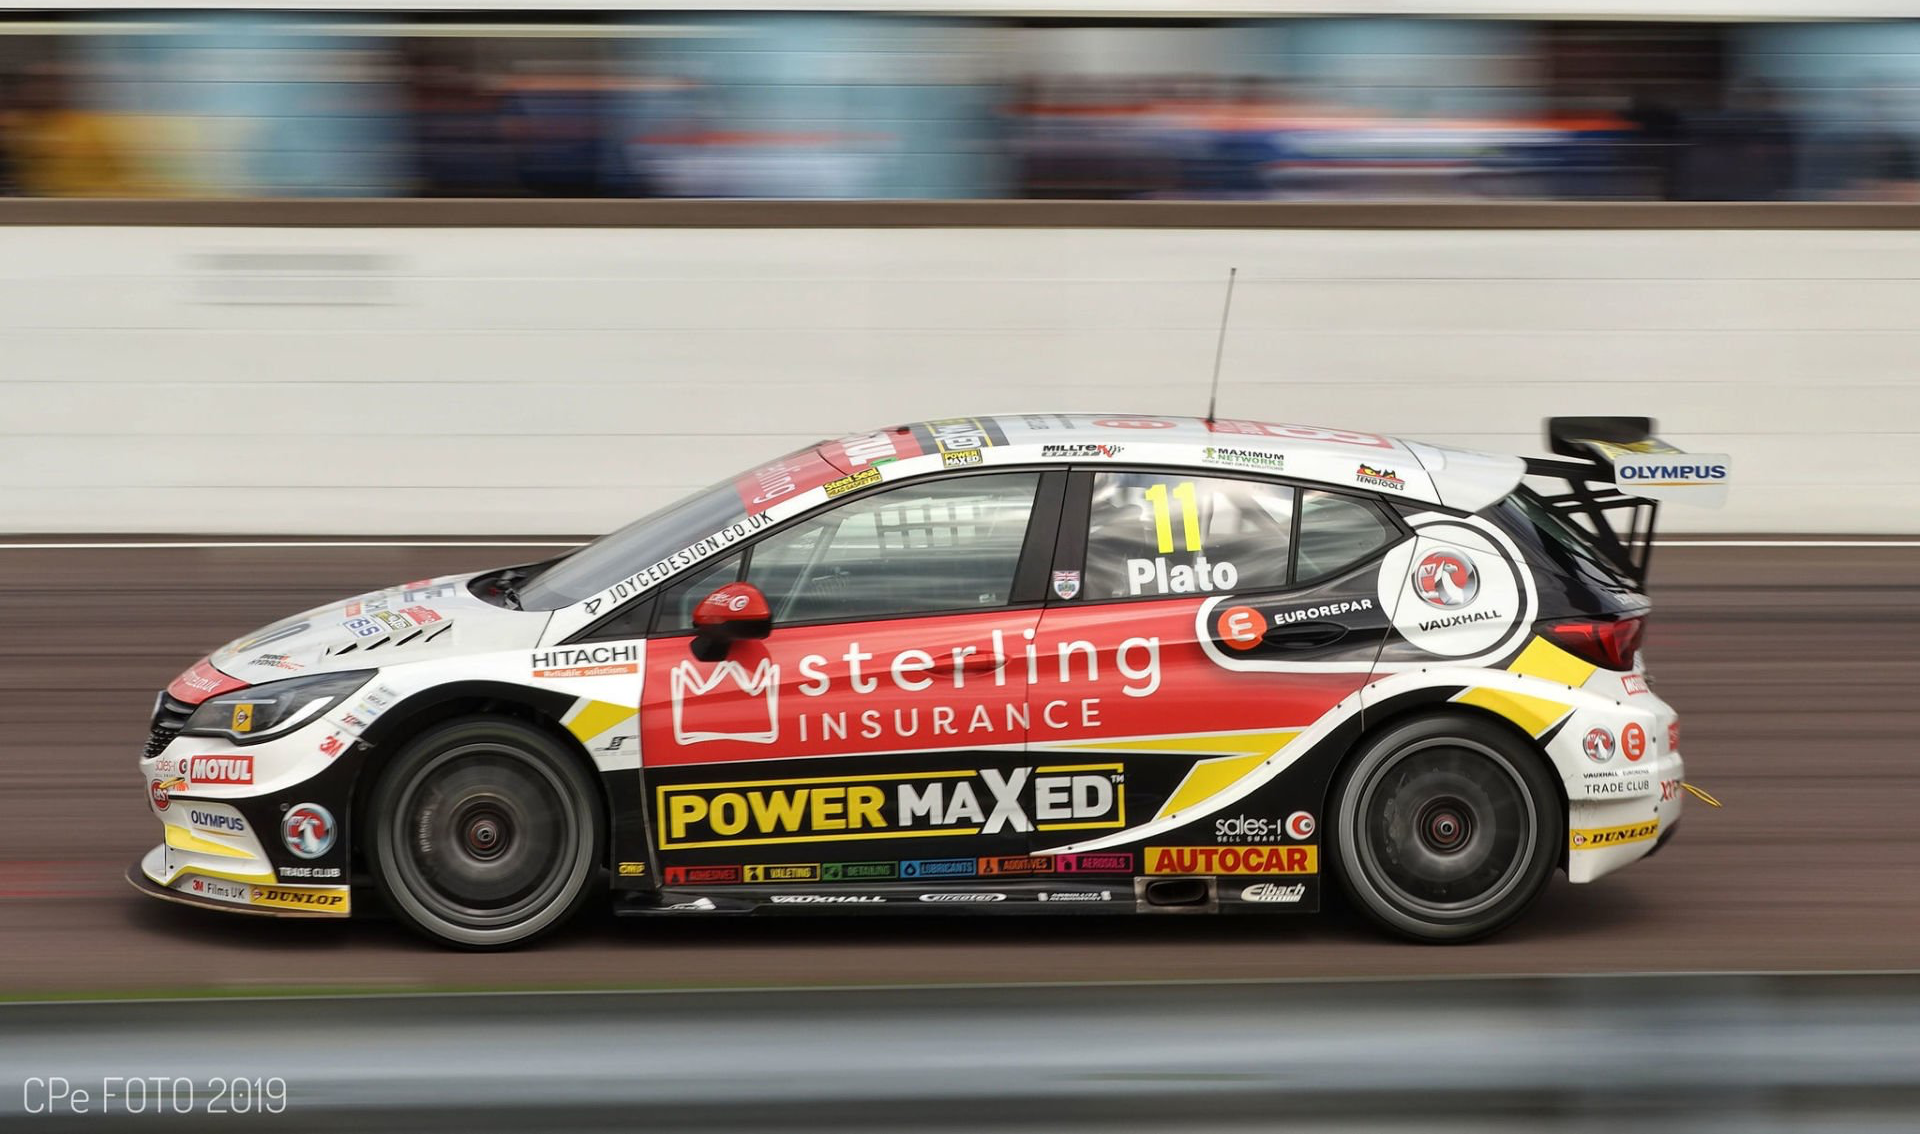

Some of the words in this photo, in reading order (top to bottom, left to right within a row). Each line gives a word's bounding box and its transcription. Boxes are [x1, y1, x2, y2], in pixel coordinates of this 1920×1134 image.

[944, 450, 979, 459] POWER
[945, 456, 980, 466] MAXED
[1218, 448, 1284, 461] MAXIMUM
[1218, 454, 1284, 467] NETWORKS
[824, 476, 854, 491] Steel
[853, 467, 879, 481] Seal
[1620, 465, 1726, 479] OLYMPUS
[1145, 482, 1201, 554] 11
[608, 510, 774, 603] JOYCEDESIGN.CO.UK
[1127, 557, 1238, 595] Plato
[1274, 598, 1373, 626] EUROREPAR
[1419, 609, 1502, 632] VAUXHALL
[532, 645, 638, 668] HITACHI
[798, 629, 1161, 697] sterling
[799, 697, 1102, 742] INSURANCE
[320, 735, 344, 758] 3M
[194, 759, 251, 780] MOTUL
[1583, 771, 1617, 779] VAUXHALL
[1585, 781, 1624, 795] TRADE
[1626, 779, 1650, 792] CLUB
[668, 785, 888, 838] POWER
[897, 766, 1114, 834] MAXED
[191, 810, 244, 831] OLYMPUS
[1590, 823, 1659, 844] DUNLOP
[921, 860, 974, 874] LUBRICANTS
[1003, 858, 1048, 871] ADDITIVES
[1082, 857, 1126, 869] AEROSOLS
[1154, 847, 1308, 873] AUTOCAR
[279, 867, 312, 877] TRADE
[313, 868, 341, 877] CLUB
[770, 867, 811, 878] VALETING
[848, 865, 890, 876] DETAILING
[192, 879, 204, 892] 3M
[207, 883, 229, 897] Films
[231, 887, 245, 899] UK
[266, 890, 343, 905] DUNLOP
[1241, 883, 1306, 902] Eibach
[770, 895, 887, 903] VAUXHALL
